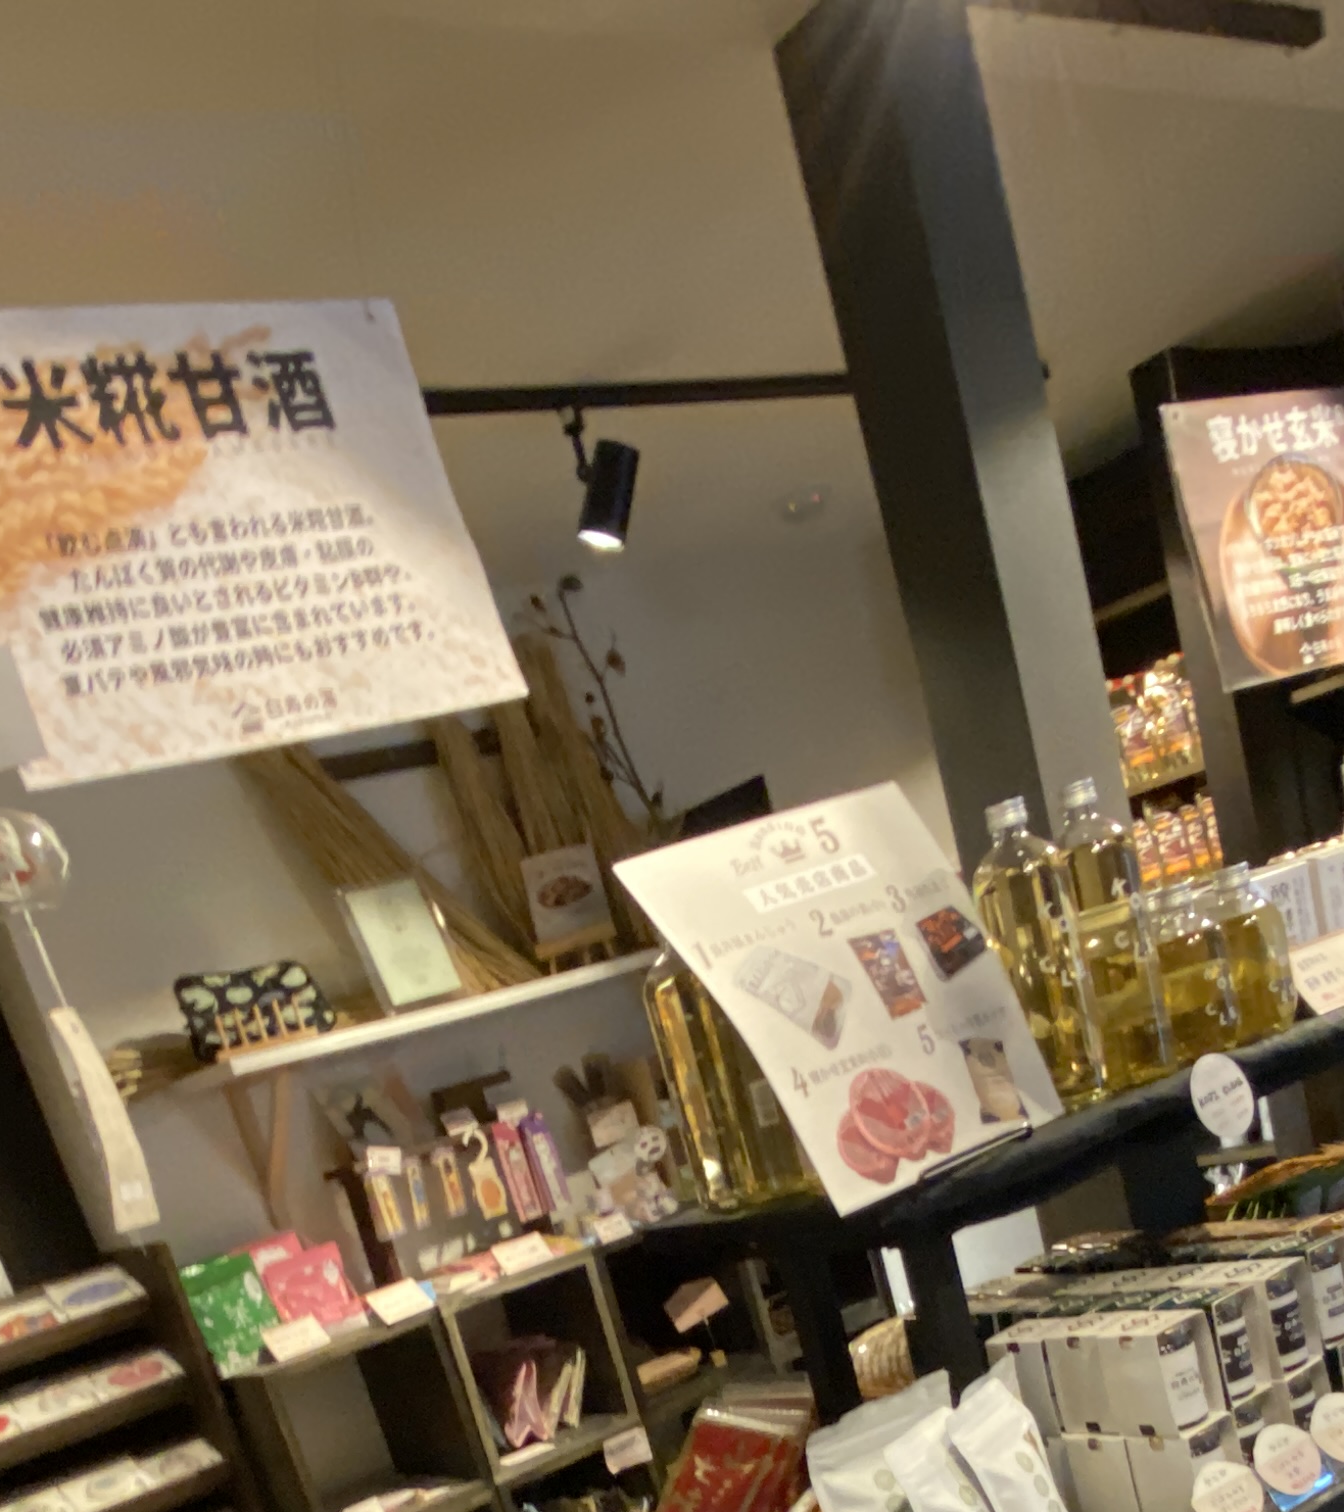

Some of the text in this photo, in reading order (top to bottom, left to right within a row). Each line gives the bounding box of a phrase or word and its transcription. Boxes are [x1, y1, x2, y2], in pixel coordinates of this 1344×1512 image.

[808, 815, 840, 854] 5
[885, 884, 907, 914] 3
[808, 908, 834, 939] 2
[916, 1023, 936, 1055] 5
[790, 1065, 809, 1098] 4
